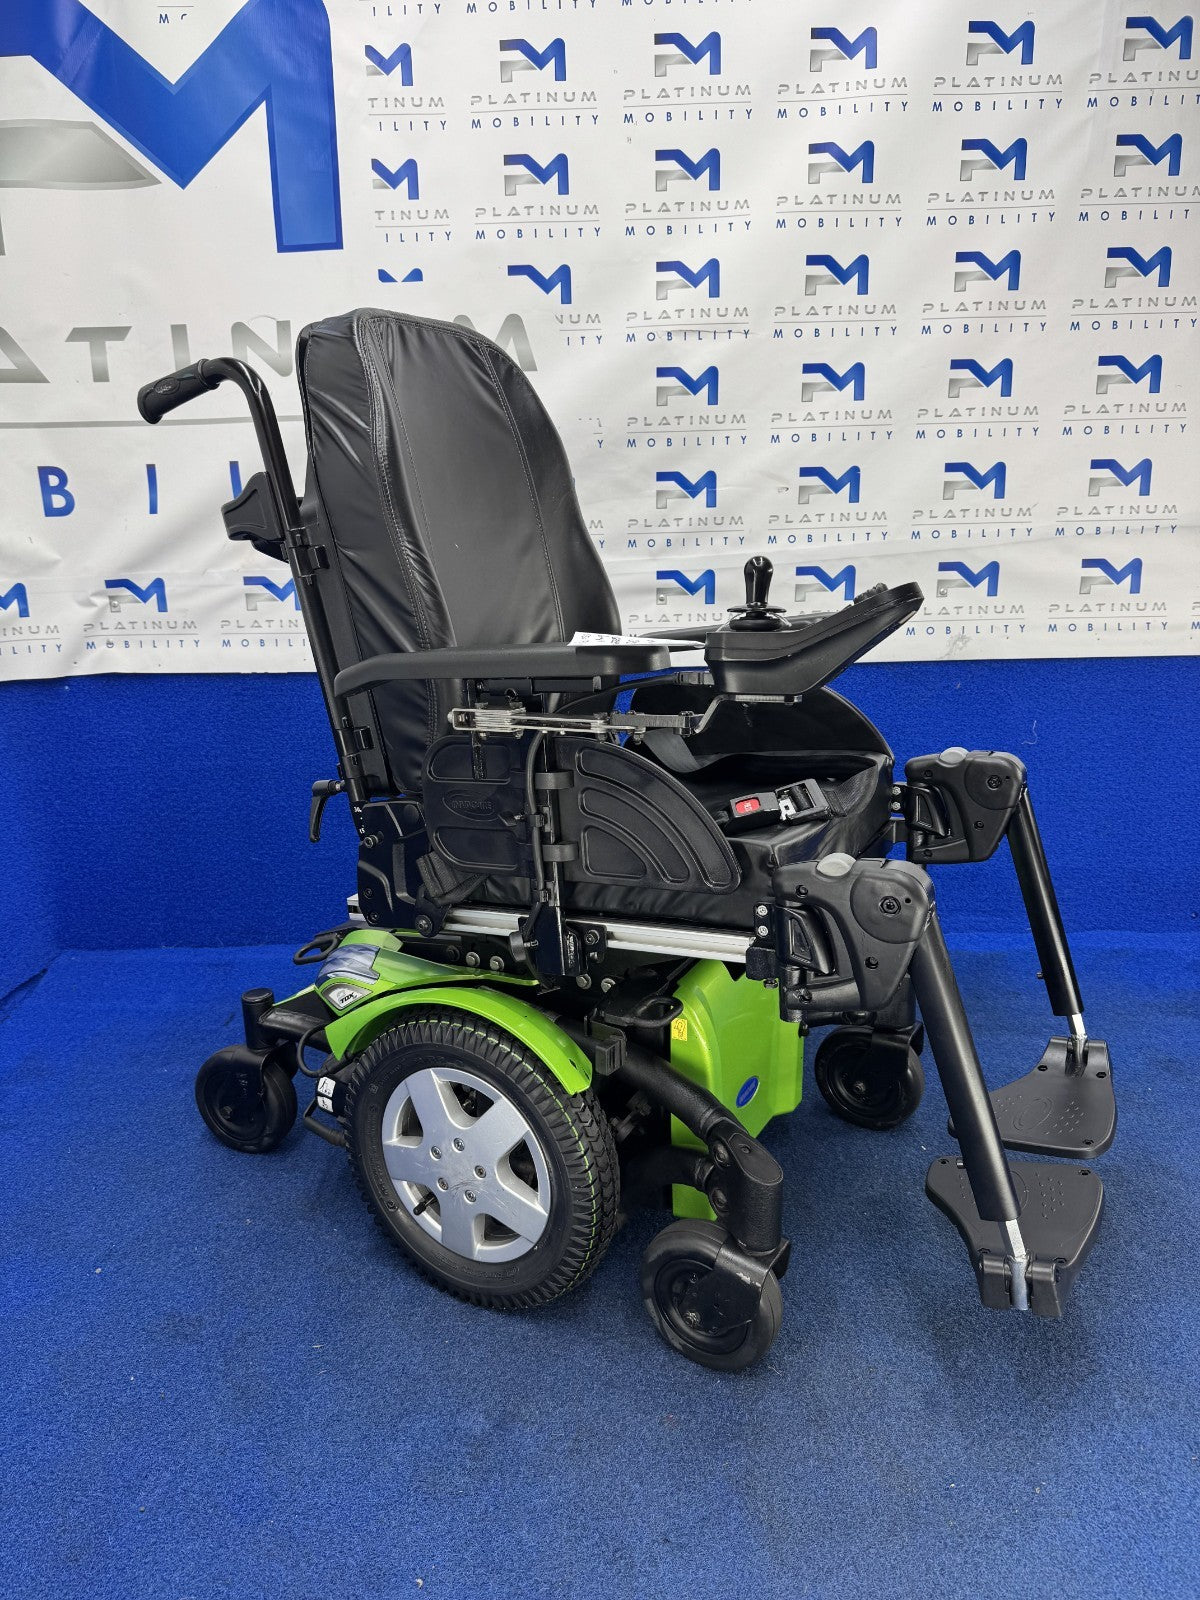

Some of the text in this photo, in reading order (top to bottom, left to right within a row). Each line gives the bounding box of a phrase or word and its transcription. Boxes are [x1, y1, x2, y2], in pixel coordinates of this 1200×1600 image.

[778, 77, 907, 95] PLATINUM
[931, 74, 1062, 88] PLATINUM
[471, 91, 597, 105] PLATINUM
[624, 85, 751, 100] PLATINUM
[777, 100, 909, 118] MOBILITY
[928, 96, 1062, 112] MOBILITY
[472, 115, 598, 129] MOBILITY
[624, 109, 752, 126] MOBILITY
[777, 194, 901, 206] PLATINUM
[928, 189, 1054, 203] PLATINUM
[475, 204, 599, 217] PLATINUM
[625, 199, 749, 213] PLATINUM
[776, 216, 902, 229] MOBILITY
[926, 212, 1055, 226] MOBILITY
[476, 227, 600, 239] MOBILITY
[625, 221, 751, 236] MOBILITY
[923, 300, 1046, 313] PLATINUM
[1072, 296, 1197, 309] PLATINUM
[627, 307, 749, 321] PLATINUM
[775, 304, 896, 316] PLATINUM
[921, 322, 1046, 334] MOBILITY
[1070, 317, 1197, 331] MOBILITY
[626, 328, 754, 342] MOBILITY
[773, 326, 897, 338] MOBILITY
[918, 406, 1038, 418] PLATINUM
[1064, 403, 1186, 414] PLATINUM
[627, 414, 746, 426] PLATINUM
[771, 410, 892, 422] PLATINUM
[916, 427, 1039, 439] MOBILITY
[1062, 424, 1187, 435] MOBILITY
[627, 435, 747, 448] MOBILITY
[770, 431, 893, 443] MOBILITY
[912, 507, 1032, 520] PLATINUM
[1057, 505, 1177, 516] PLATINUM
[628, 515, 743, 528] PLATINUM
[769, 511, 887, 524] PLATINUM
[911, 528, 1032, 539] MOBILITY
[1055, 524, 1177, 536] MOBILITY
[628, 536, 744, 548] MOBILITY
[768, 532, 888, 544] MOBILITY
[1049, 602, 1166, 613] PLATINUM
[83, 619, 198, 632] PLATINUM
[905, 624, 1025, 636] MOBILITY
[1048, 622, 1168, 632] MOBILITY
[86, 638, 200, 650] MOBILITY
